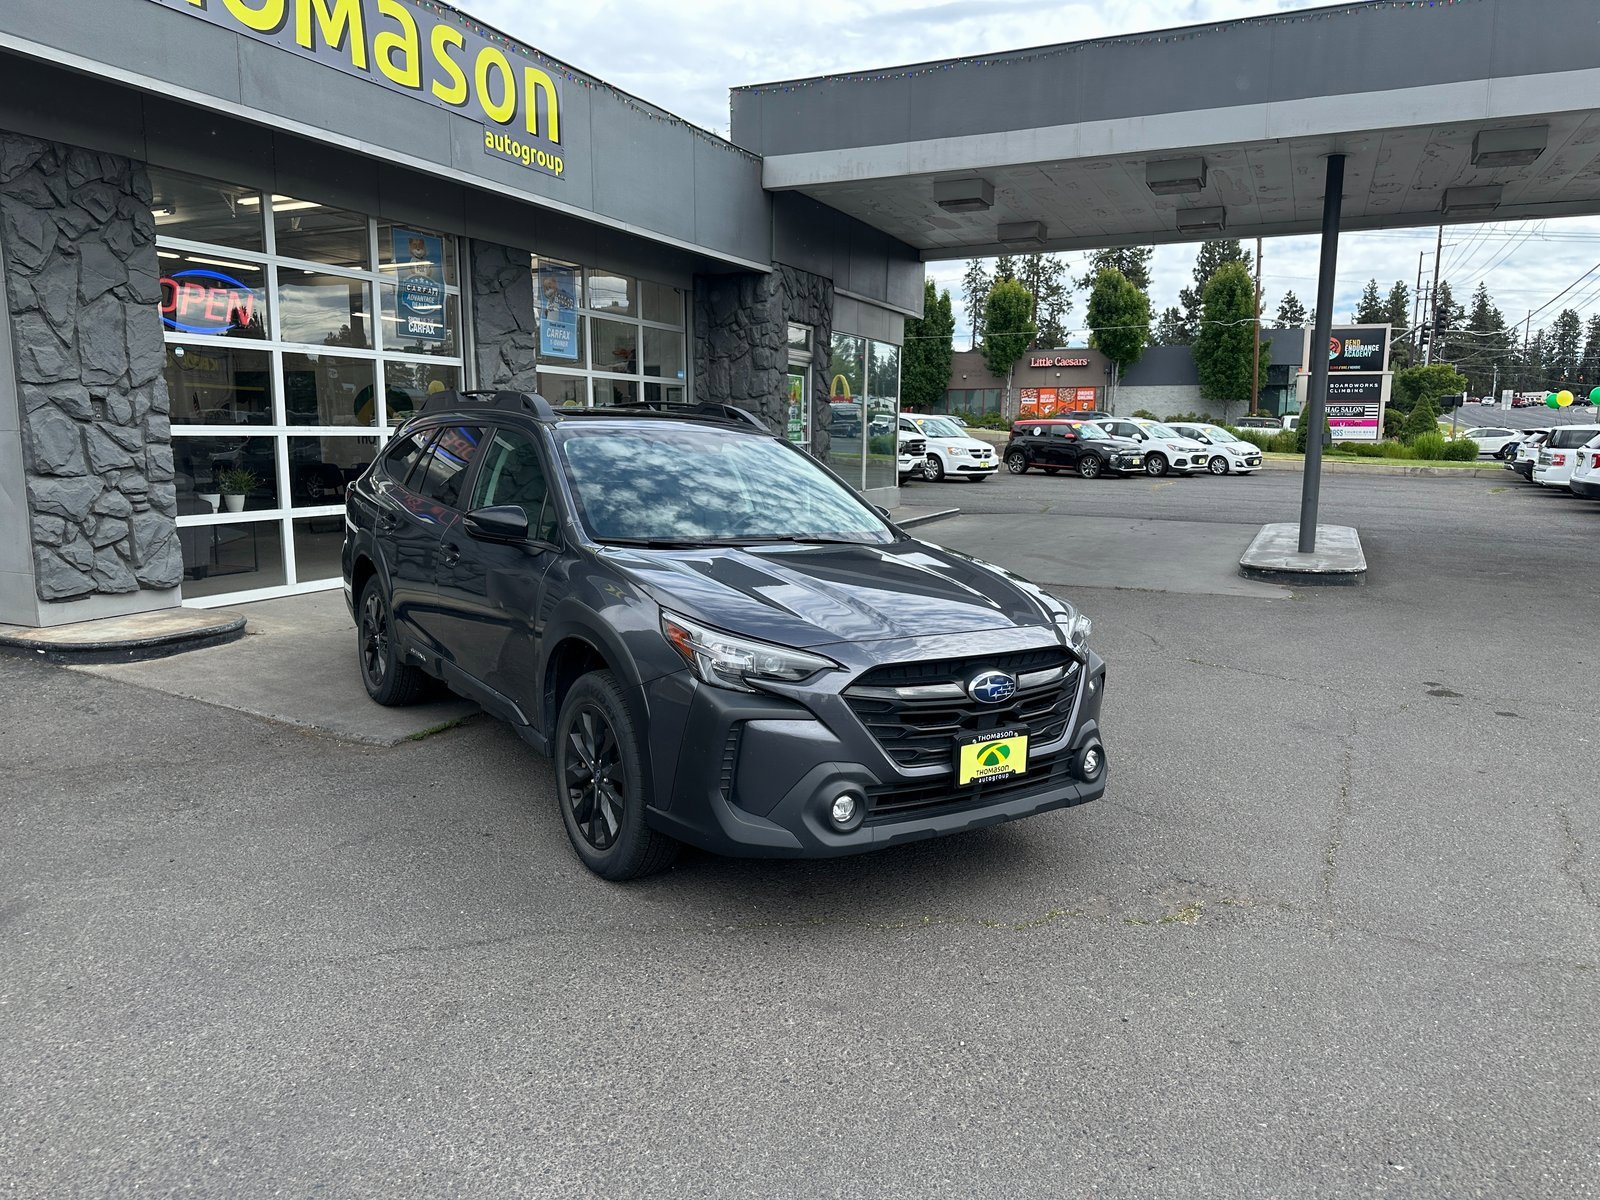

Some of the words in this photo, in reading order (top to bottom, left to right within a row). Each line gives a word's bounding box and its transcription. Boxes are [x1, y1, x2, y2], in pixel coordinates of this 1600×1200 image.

[484, 129, 564, 176] autogroup
[406, 284, 438, 297] CARFAX
[159, 277, 254, 326] OPEN
[406, 293, 435, 304] ADVANTAGE
[408, 322, 436, 335] CARFAX
[546, 327, 571, 340] CARFAX
[1343, 350, 1372, 358] ACADEMY
[1344, 344, 1380, 352] ENDURANCE
[1030, 357, 1053, 367] Little
[1054, 356, 1088, 366] Caesars
[978, 773, 1010, 783] autogroup
